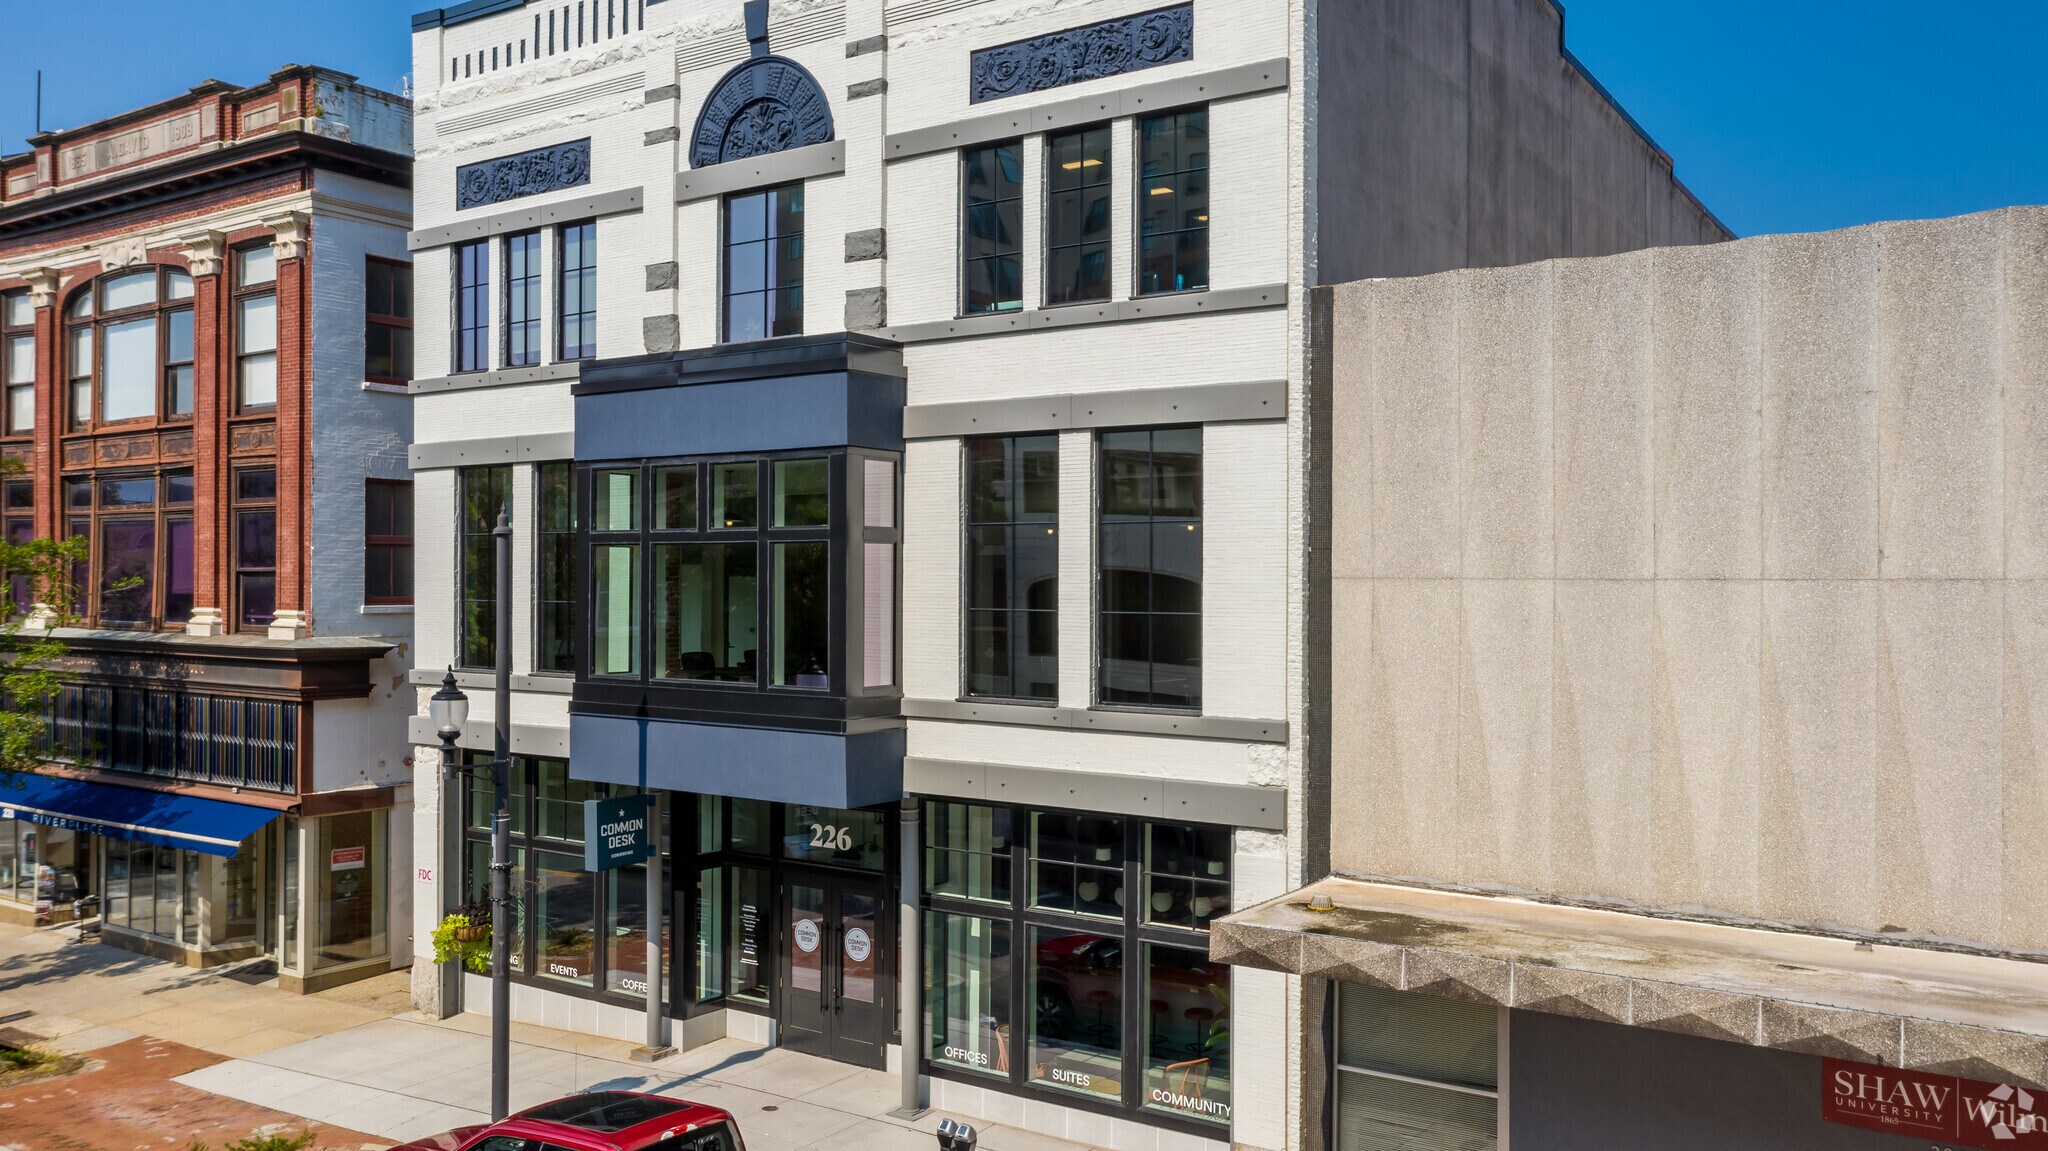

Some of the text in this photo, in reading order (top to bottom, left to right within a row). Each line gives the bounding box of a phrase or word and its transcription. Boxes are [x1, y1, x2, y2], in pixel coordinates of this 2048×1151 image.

[600, 818, 643, 837] COMMON
[809, 823, 852, 851] 226
[608, 833, 635, 849] DESK
[418, 868, 432, 881] FDC
[797, 929, 817, 938] COMMON
[847, 938, 868, 947] COMMON
[550, 963, 578, 978] EVENTS
[944, 1046, 988, 1065] OFFICES
[1052, 1068, 1090, 1087] SUITES
[1834, 1070, 1951, 1112] SHAW
[1152, 1089, 1231, 1117] COMMUNITY
[1835, 1096, 1943, 1123] UNIVERSITY
[1880, 1115, 1899, 1125] 1865
